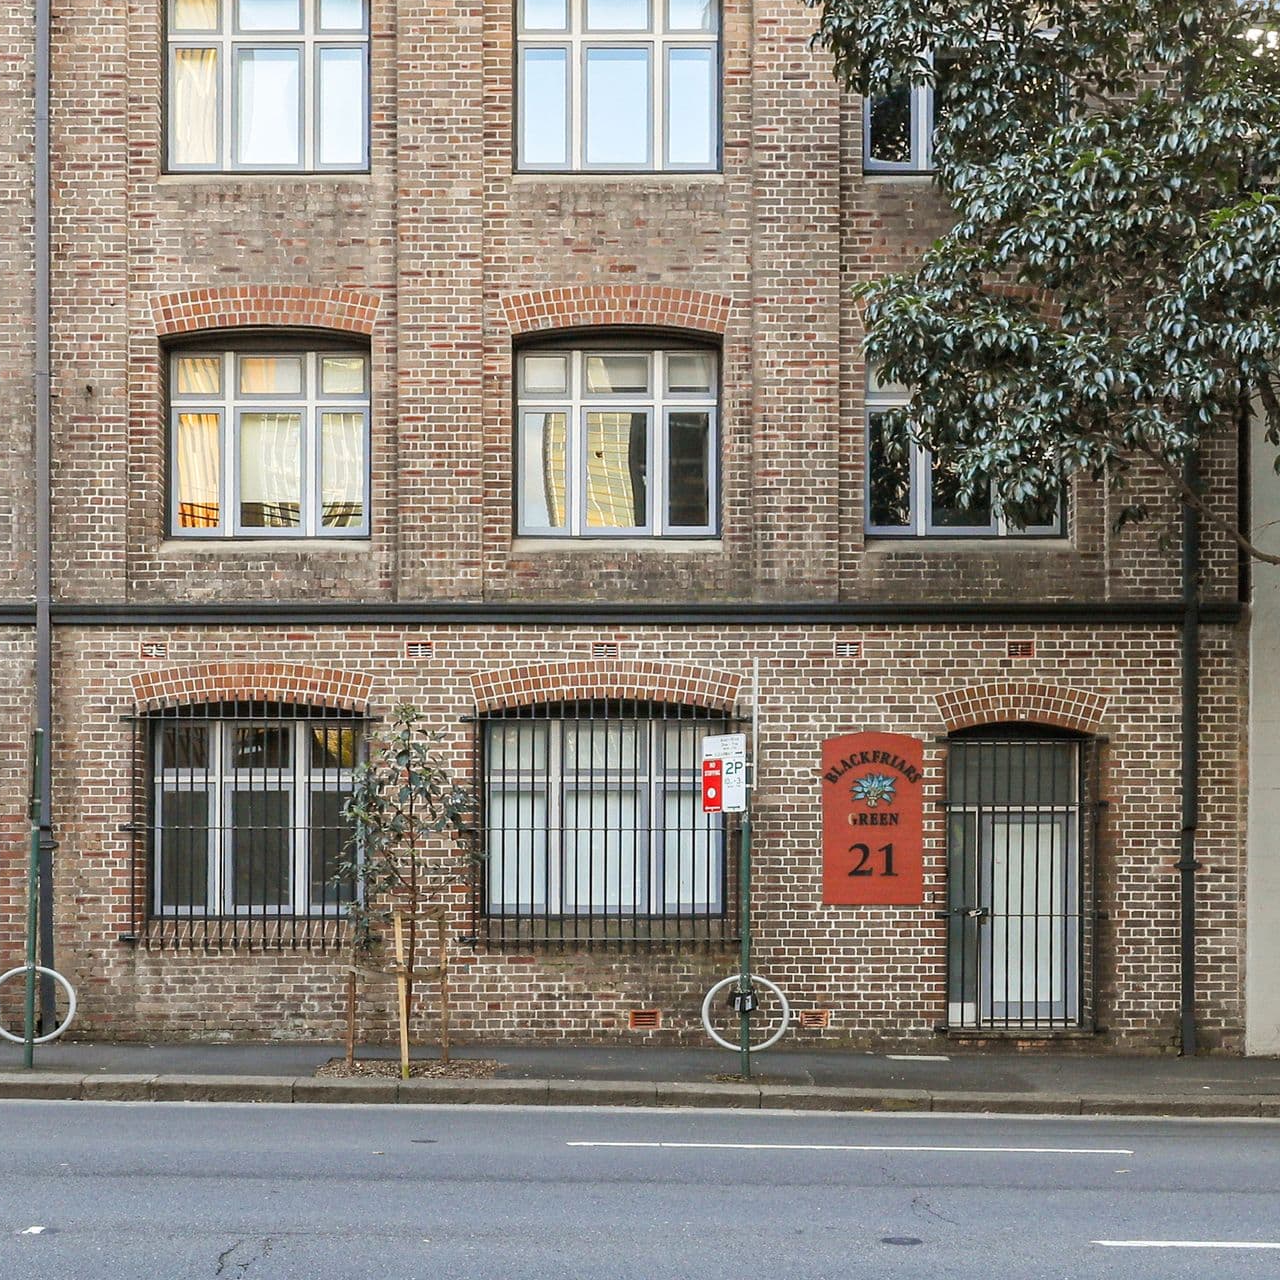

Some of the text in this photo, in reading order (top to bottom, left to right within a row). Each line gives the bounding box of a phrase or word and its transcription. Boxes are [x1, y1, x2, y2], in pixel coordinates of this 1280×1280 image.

[725, 761, 743, 775] 2P
[824, 750, 923, 785] BLACKFRIARS
[848, 812, 900, 826] GREEN
[848, 843, 899, 877] 21
